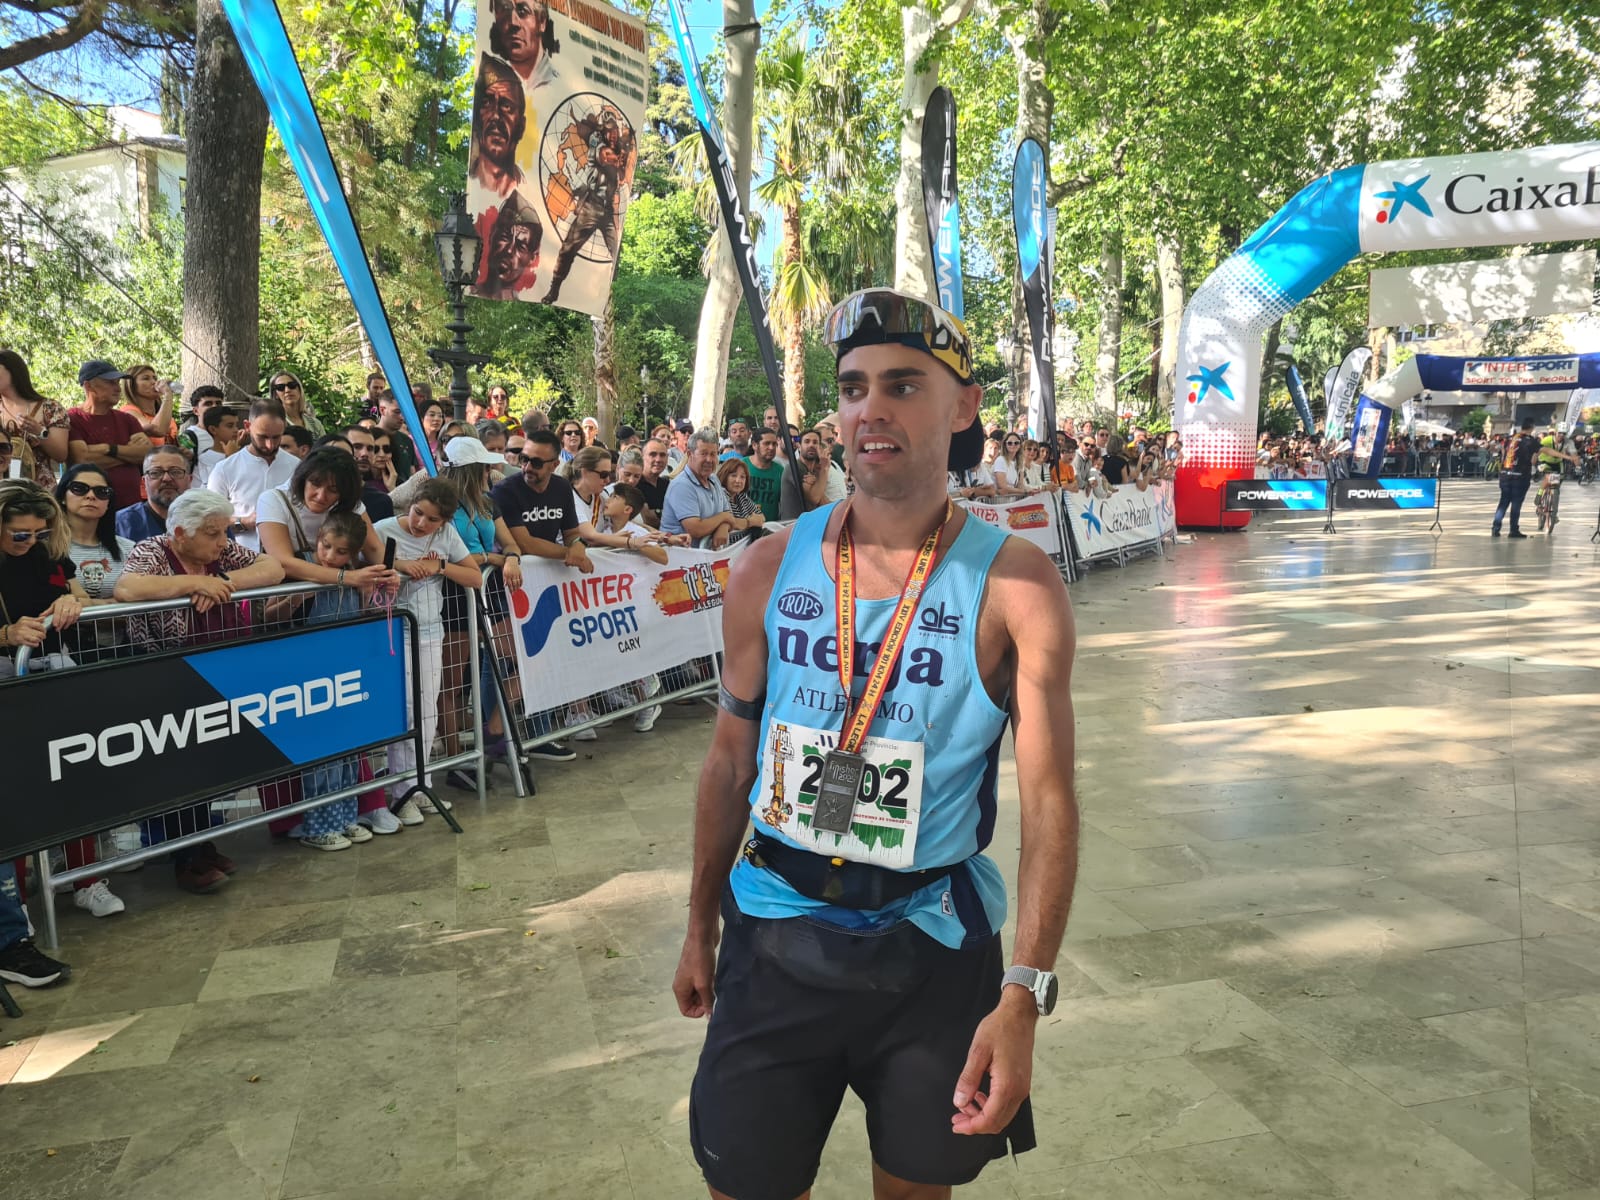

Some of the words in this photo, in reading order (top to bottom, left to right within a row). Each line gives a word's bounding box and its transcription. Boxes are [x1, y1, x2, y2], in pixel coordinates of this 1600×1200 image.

[937, 104, 953, 312] OWERADE
[1335, 370, 1360, 418] unicaja
[1238, 491, 1314, 500] POWERADE
[1348, 489, 1424, 499] POWERADE
[522, 506, 563, 522] adidas
[913, 556, 930, 576] UNE
[562, 573, 634, 613] INTER
[779, 594, 821, 617] TROPS
[841, 599, 850, 612] KM
[569, 606, 639, 647] SPORT
[841, 614, 850, 625] 101
[618, 636, 641, 653] CARY
[880, 652, 891, 665] 101
[874, 664, 886, 679] KM
[870, 678, 879, 689] 24
[866, 688, 876, 698] H
[48, 669, 363, 782] POWERADE
[854, 713, 868, 728] LA
[800, 755, 909, 807] 202
